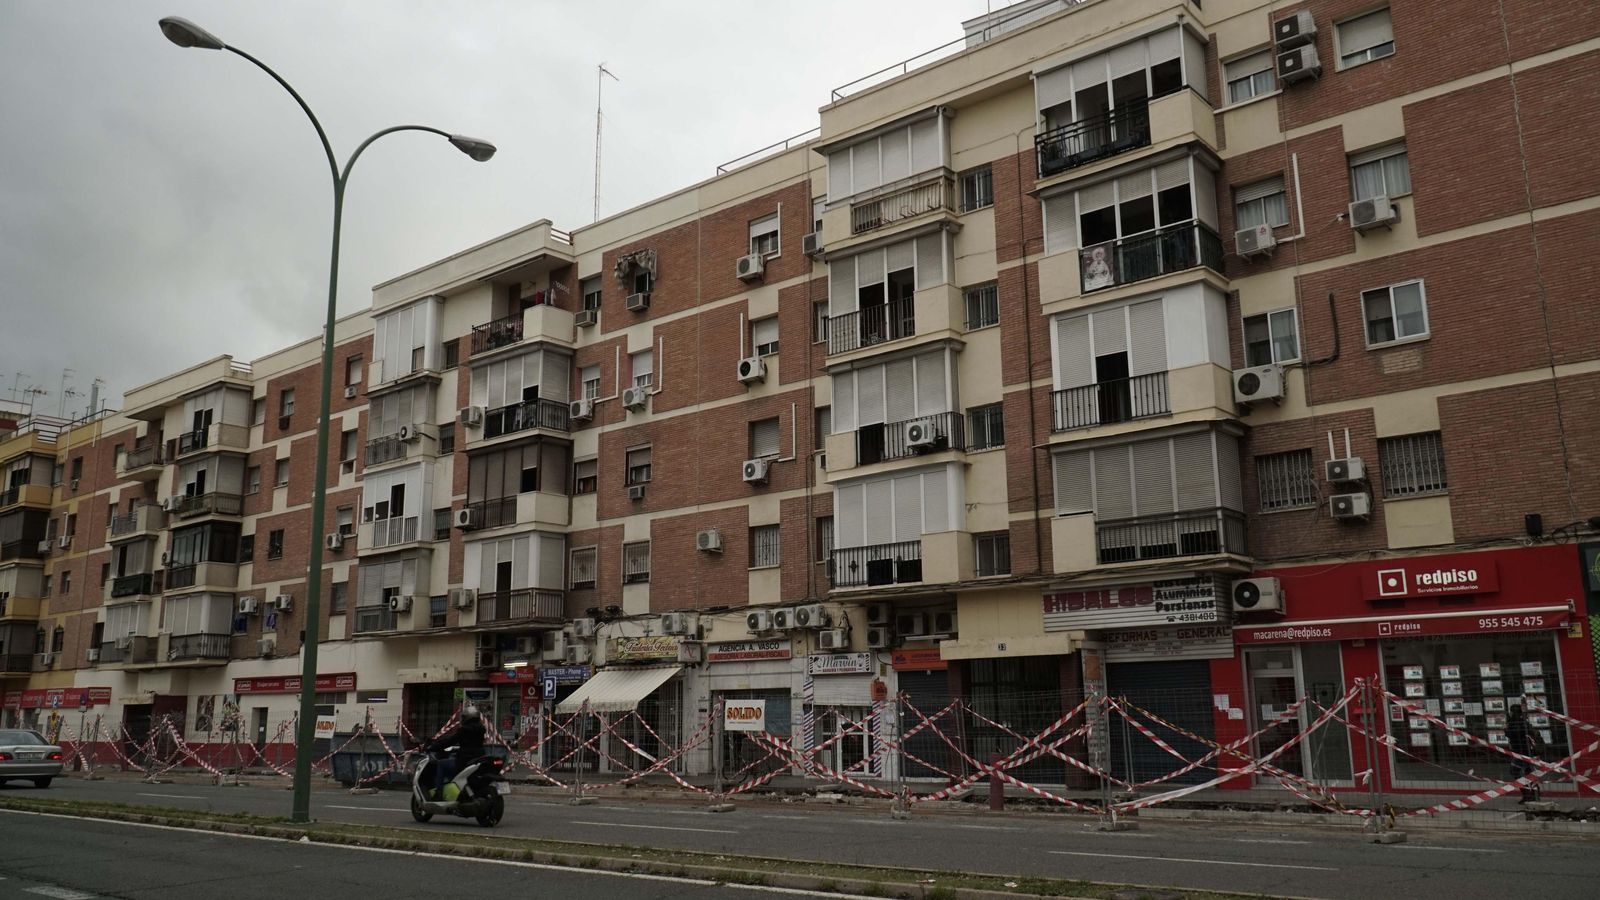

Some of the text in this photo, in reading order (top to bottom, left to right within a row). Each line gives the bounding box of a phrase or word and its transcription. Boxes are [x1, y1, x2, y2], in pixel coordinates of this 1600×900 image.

[1416, 569, 1477, 585] redpiso
[1155, 586, 1213, 600] Aluminios
[1155, 600, 1214, 612] Persianas
[1479, 616, 1543, 629] 955 545 475
[1104, 630, 1158, 643] REFORMAS
[1176, 626, 1229, 640] GENERAL
[1253, 627, 1332, 640] macarena@redpiso.es
[758, 642, 780, 650] VASCO
[545, 679, 553, 697] P
[727, 707, 762, 720] SOLIDO
